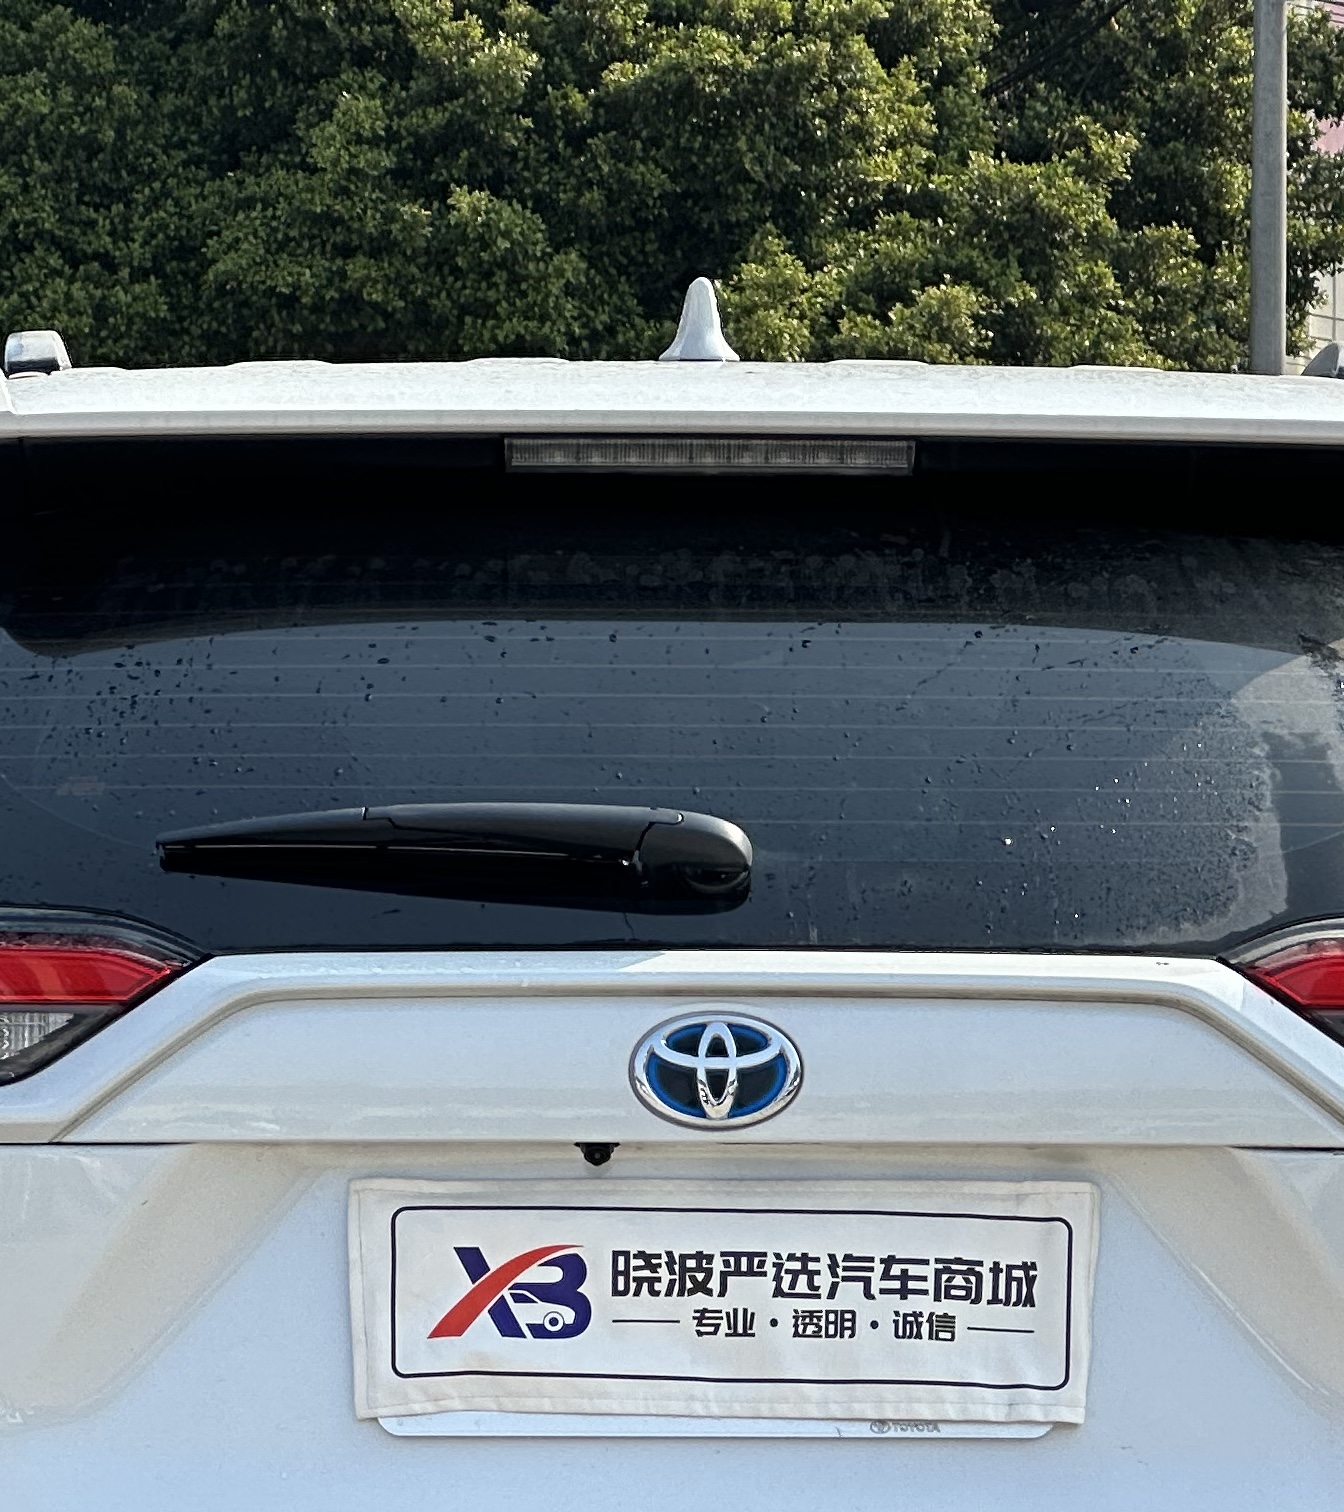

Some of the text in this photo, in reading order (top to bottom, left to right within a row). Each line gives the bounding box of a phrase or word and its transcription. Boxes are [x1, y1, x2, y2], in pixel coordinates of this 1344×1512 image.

[611, 1250, 1039, 1308] 晓波严选汽车商城
